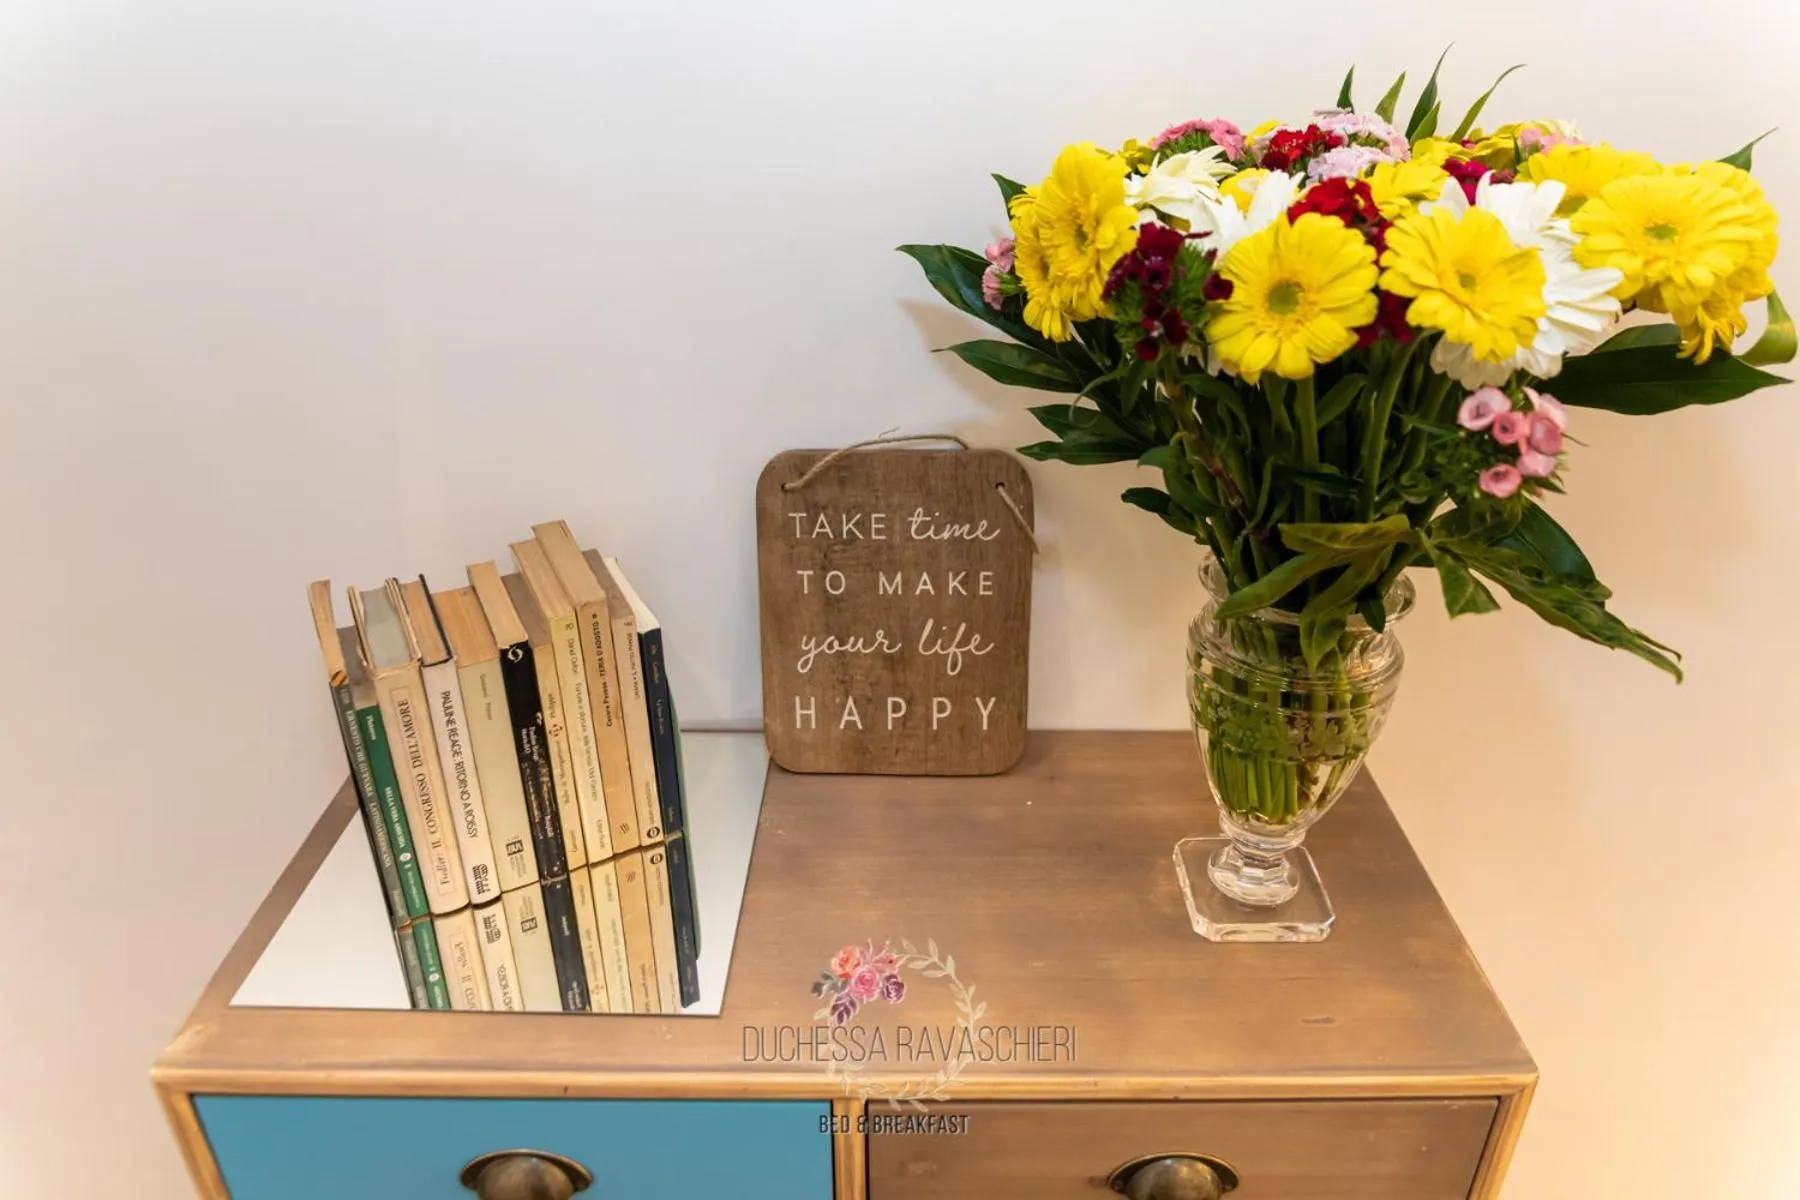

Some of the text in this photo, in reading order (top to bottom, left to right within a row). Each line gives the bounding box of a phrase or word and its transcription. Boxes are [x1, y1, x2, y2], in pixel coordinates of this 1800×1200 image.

[788, 507, 1000, 541] TAKE time
[797, 570, 994, 596] TO MAKE
[797, 618, 995, 676] your life
[795, 696, 996, 731] HAPPY
